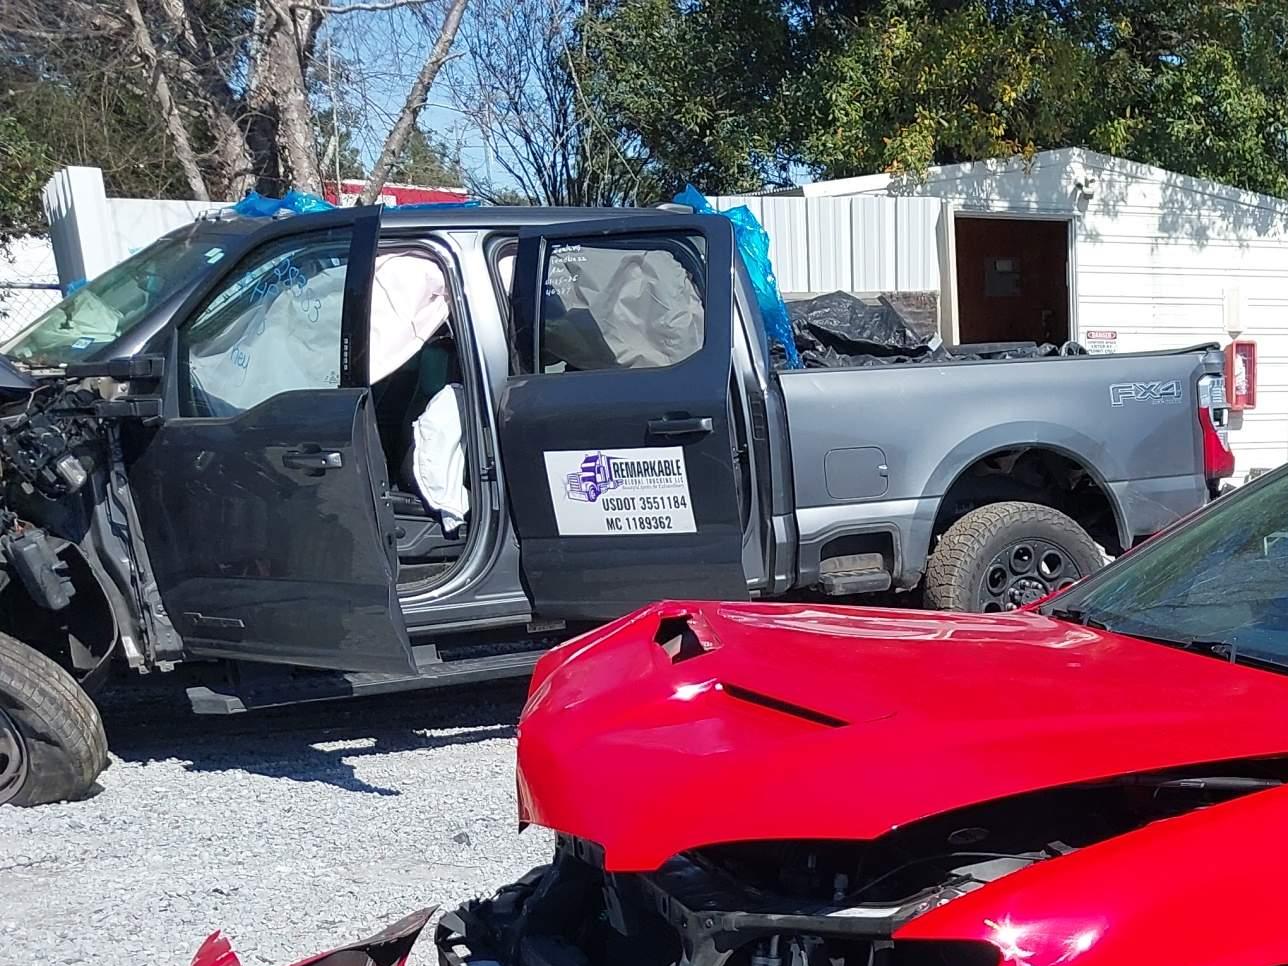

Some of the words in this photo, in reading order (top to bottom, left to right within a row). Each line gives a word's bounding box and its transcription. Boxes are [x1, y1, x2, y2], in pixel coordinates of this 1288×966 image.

[1109, 380, 1182, 408] FX4
[612, 459, 683, 479] REMARKABLE
[602, 497, 636, 512] USDOT
[639, 495, 687, 511] 3551184
[606, 517, 622, 531] MC
[626, 515, 672, 530] 1189362
